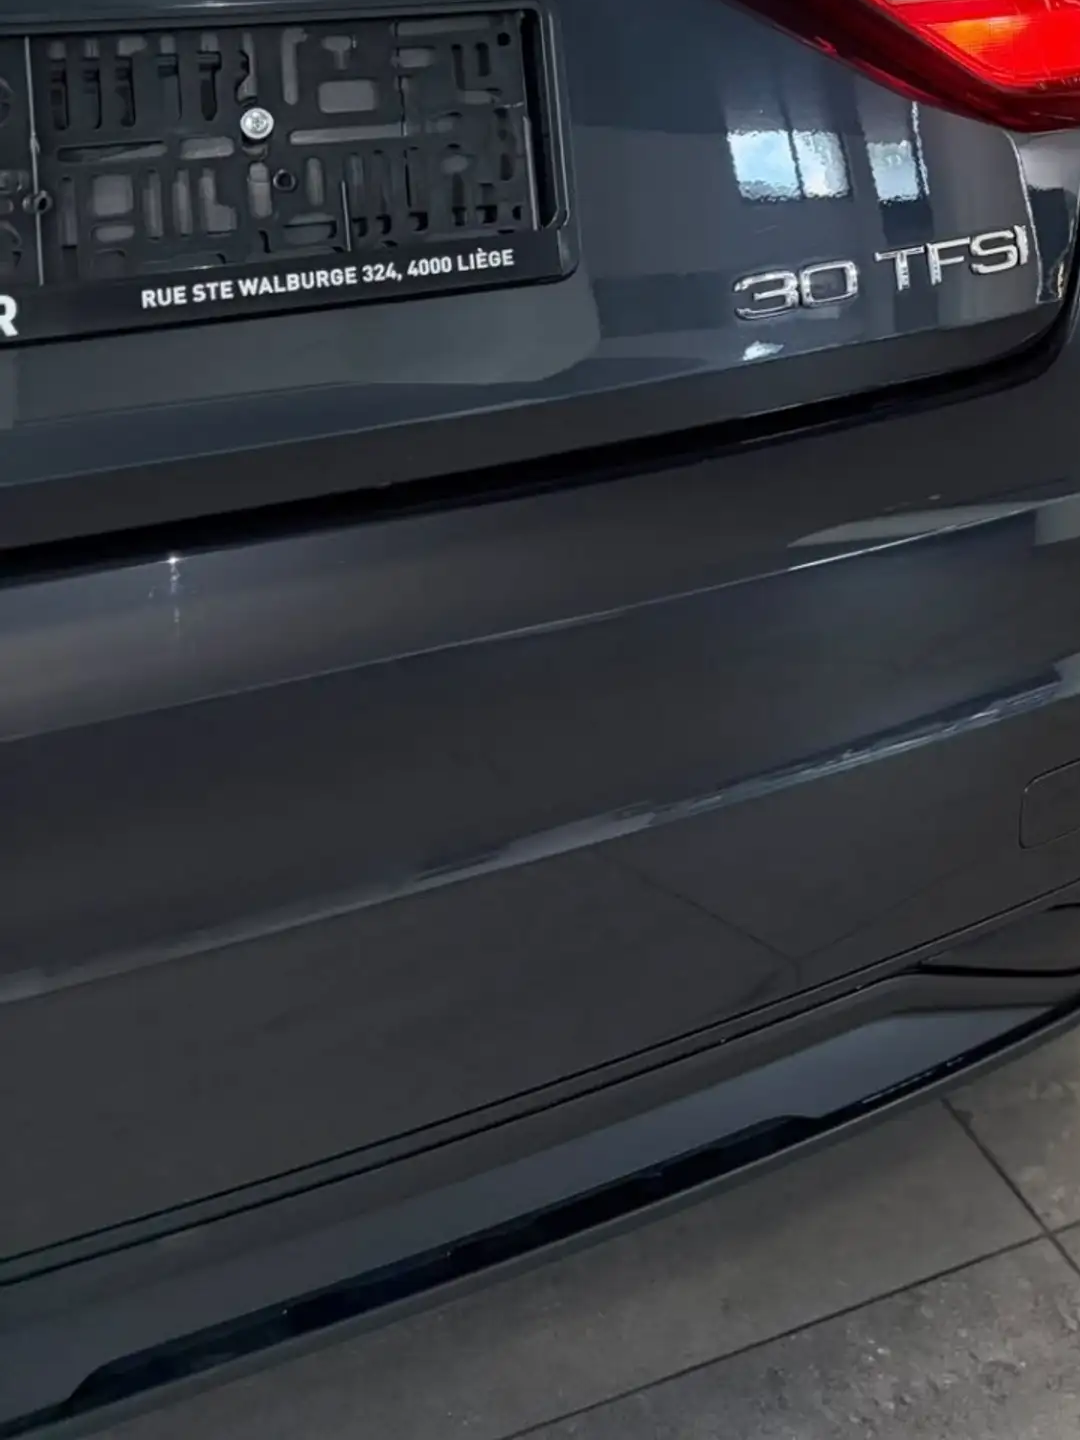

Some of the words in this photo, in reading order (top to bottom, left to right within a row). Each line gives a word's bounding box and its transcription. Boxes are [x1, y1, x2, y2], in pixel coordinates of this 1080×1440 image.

[141, 286, 188, 309] RUE
[192, 280, 235, 303] STE
[238, 267, 358, 297] WALBURGE
[362, 262, 402, 282] 324,
[407, 256, 452, 277] 4000
[457, 248, 515, 272] LIÈGE
[734, 260, 859, 320] 30
[873, 224, 1028, 292] TFSI
